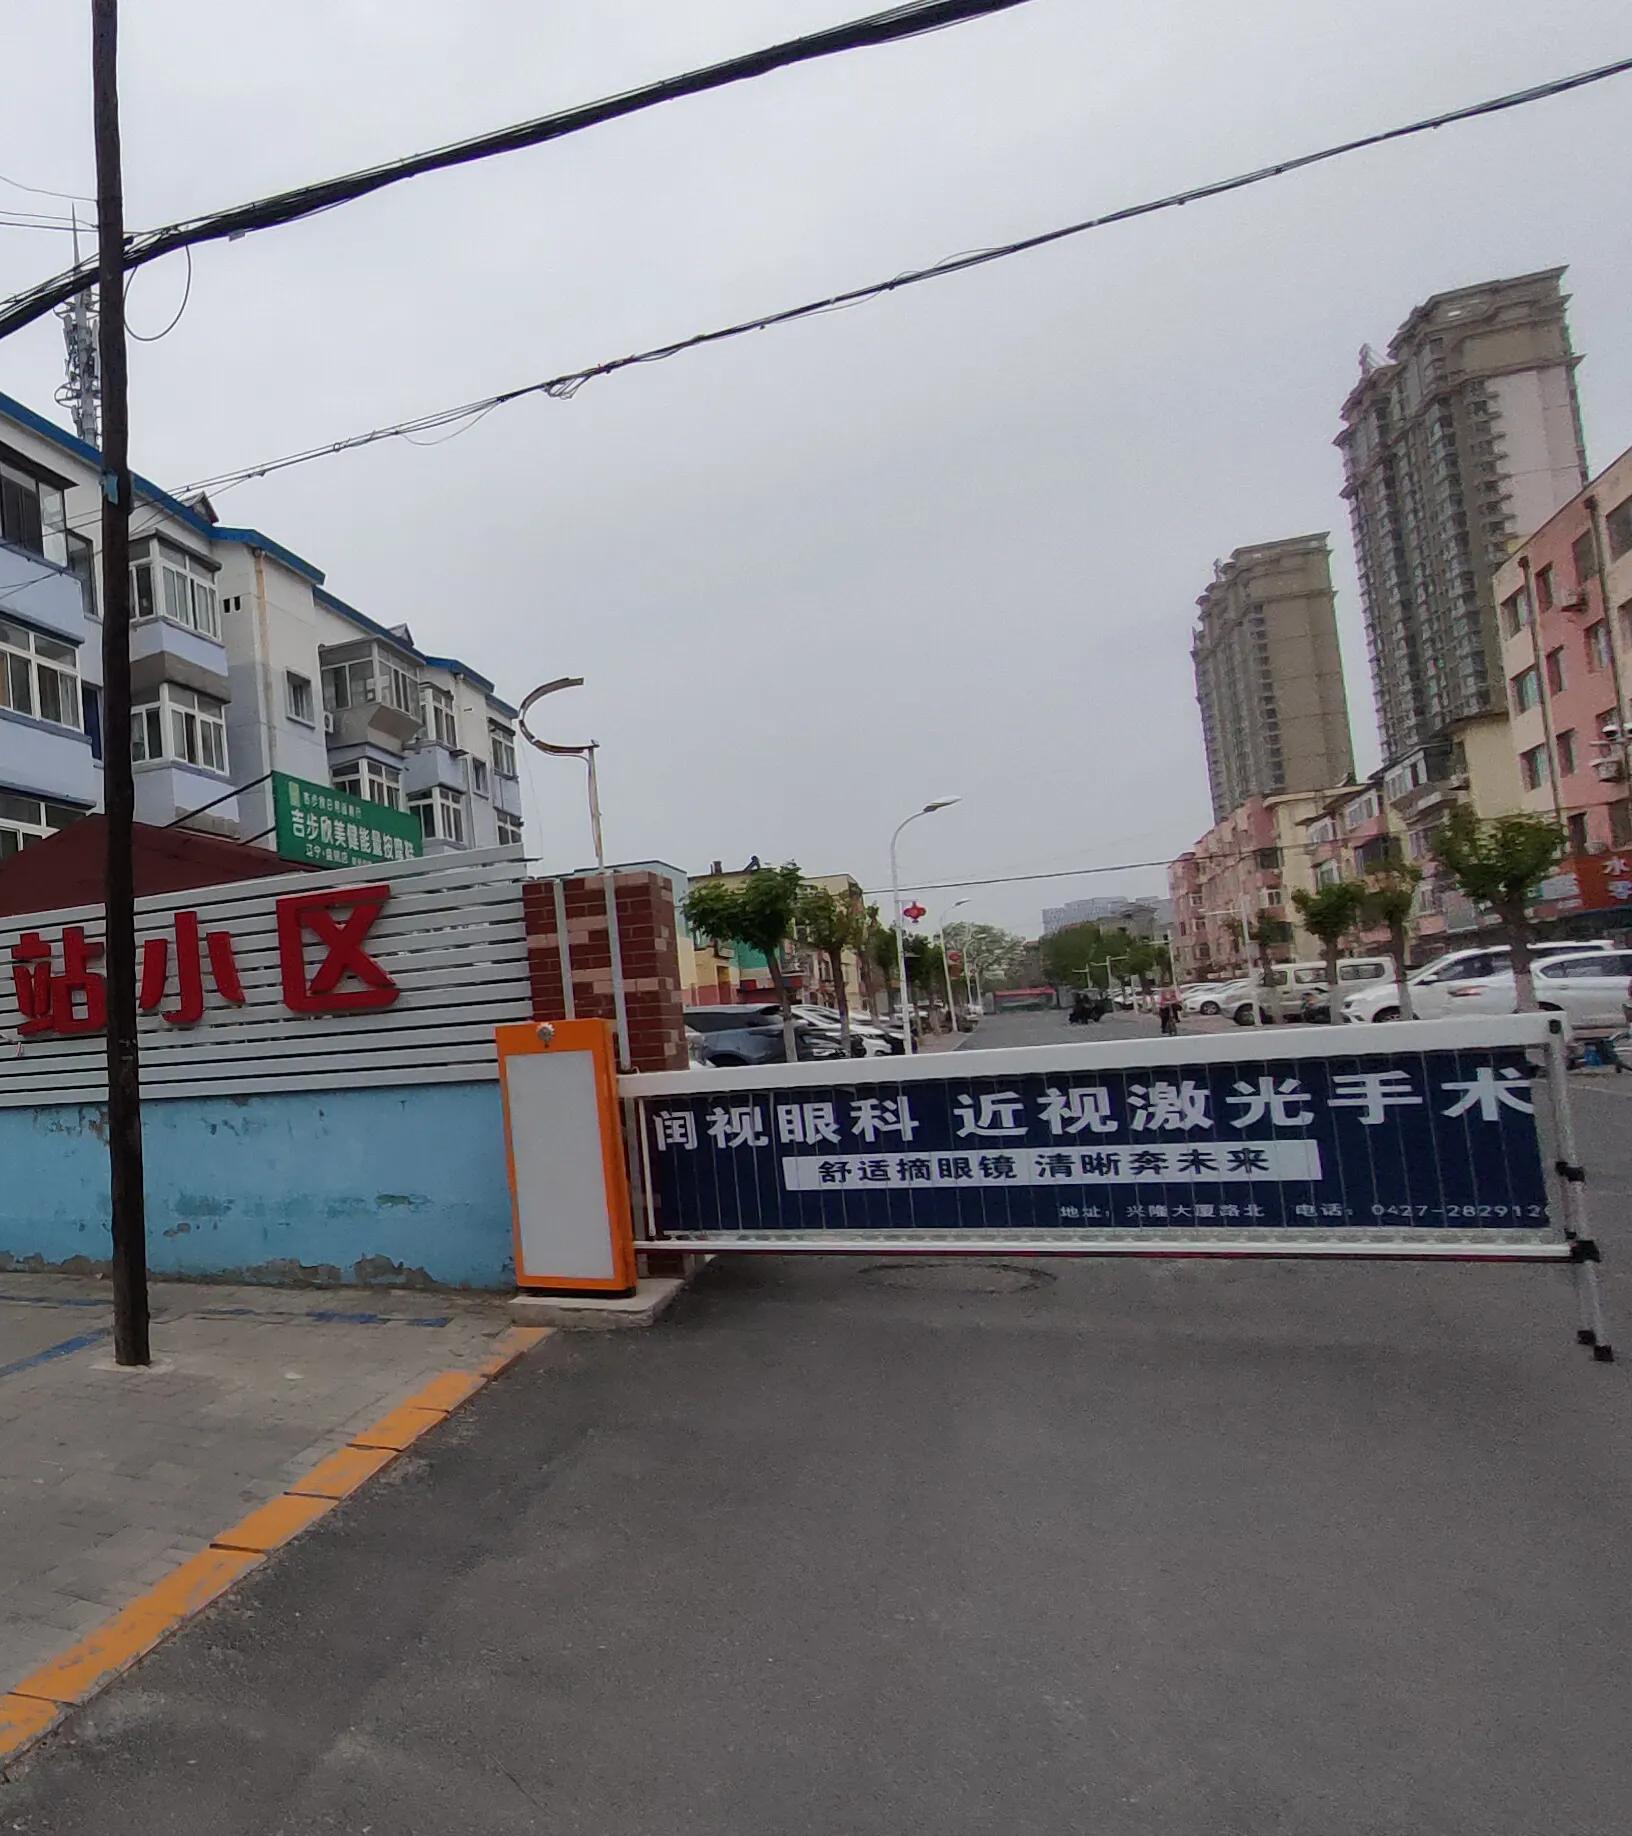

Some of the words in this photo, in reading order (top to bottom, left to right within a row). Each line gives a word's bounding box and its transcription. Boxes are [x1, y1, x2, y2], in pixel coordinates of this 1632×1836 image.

[952, 1066, 1534, 1138] 近视激光手术
[817, 1154, 1018, 1184] 舒适摘眼镜
[1034, 1148, 1270, 1179] 清晰奔未来
